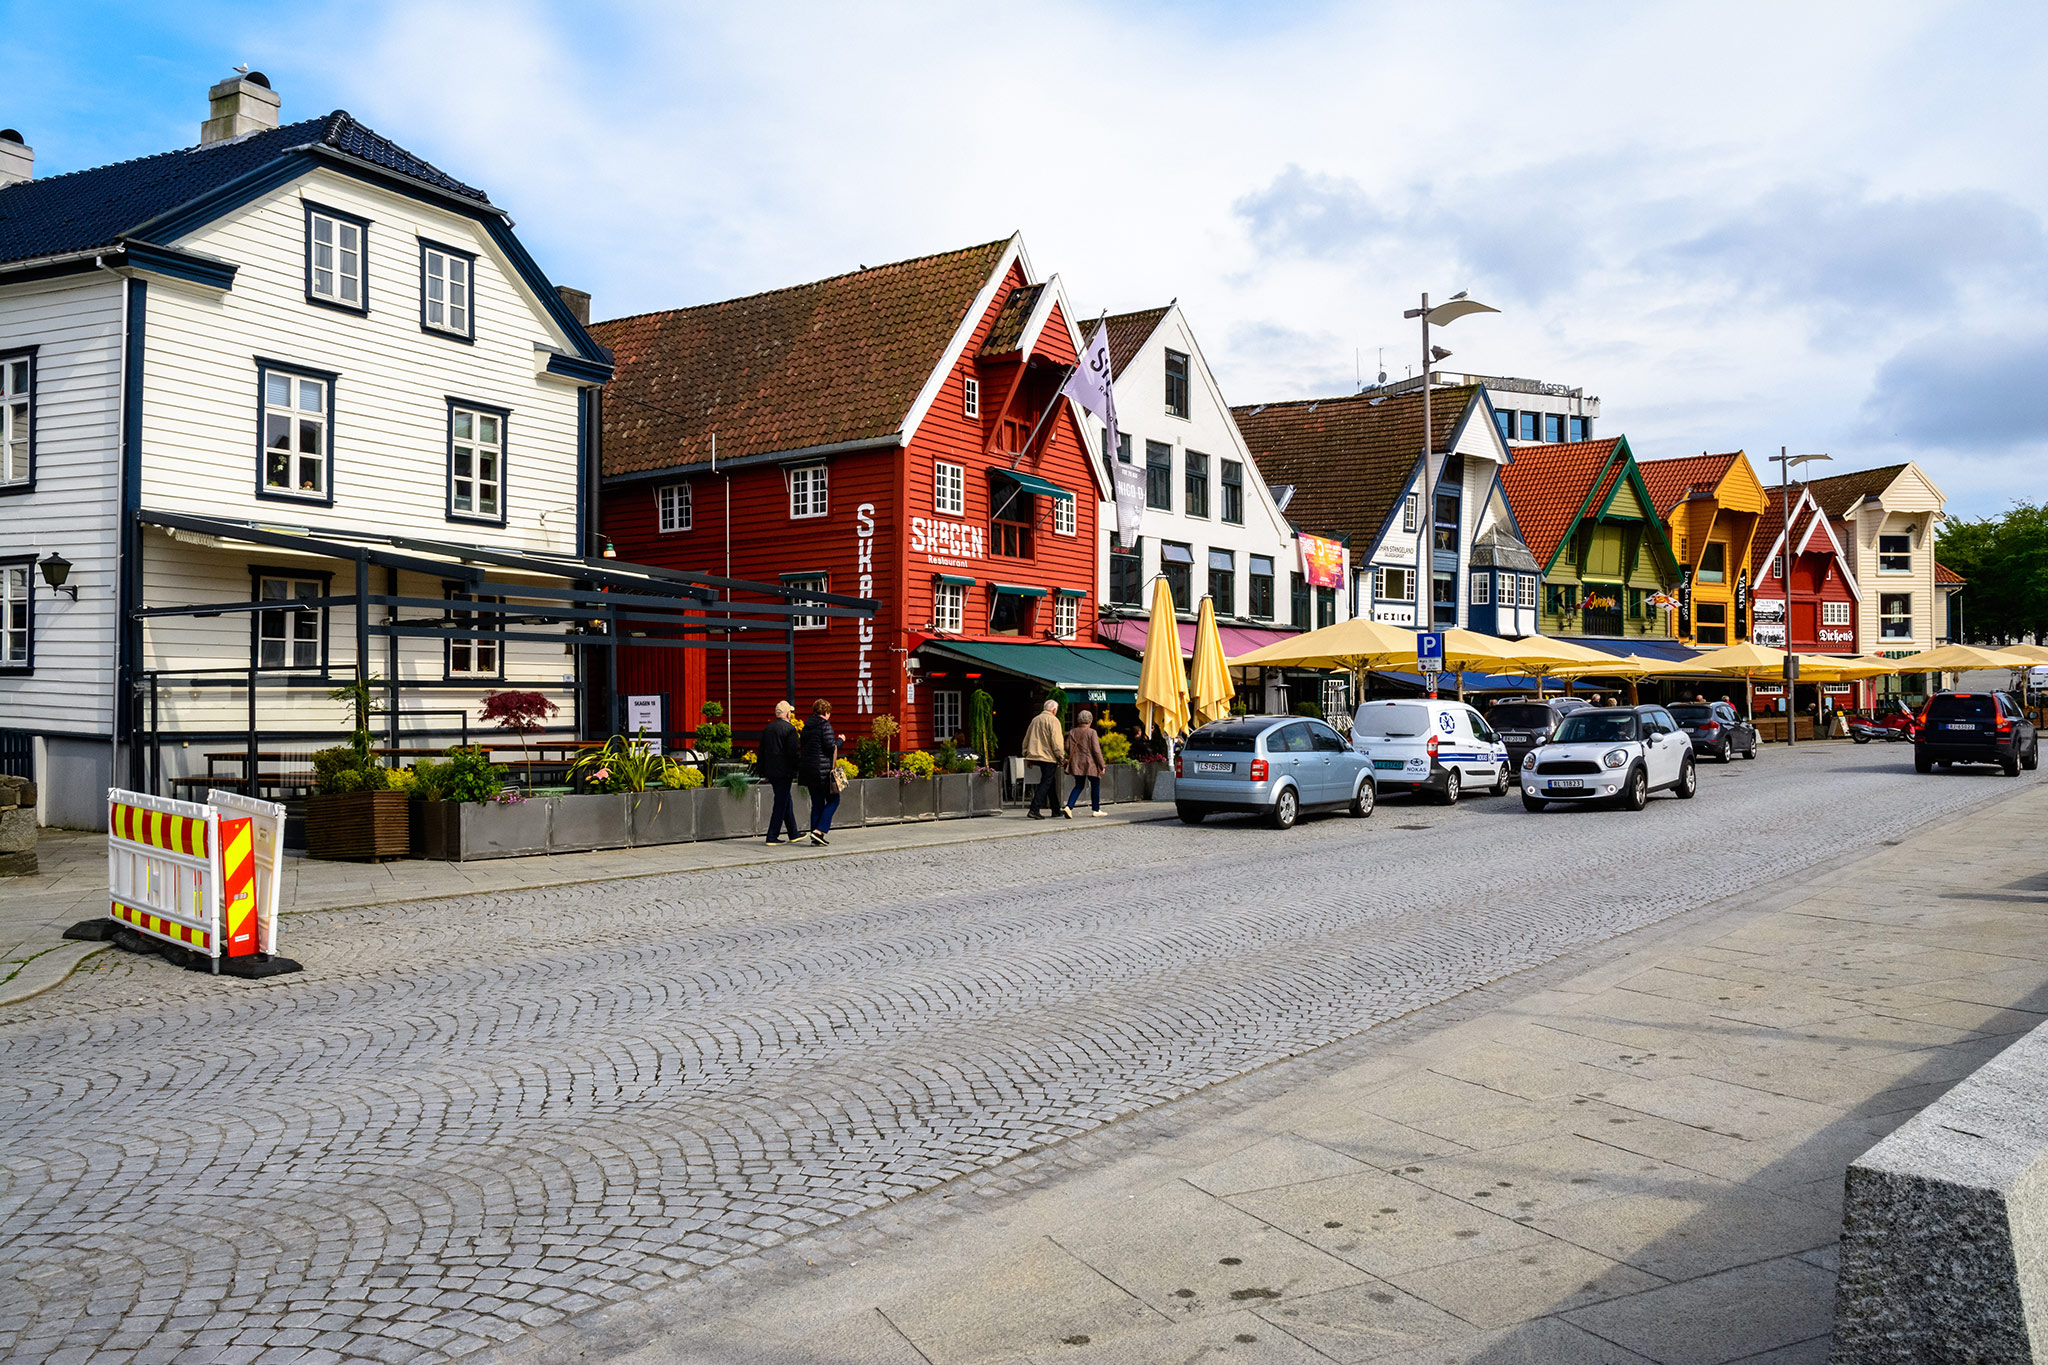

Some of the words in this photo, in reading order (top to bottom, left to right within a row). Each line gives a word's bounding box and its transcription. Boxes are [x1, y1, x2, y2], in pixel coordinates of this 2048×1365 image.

[912, 516, 983, 559] SKAGEN
[928, 554, 968, 568] Restaurant
[857, 503, 875, 714] SKAGEN
[1423, 636, 1436, 656] P
[1819, 629, 1853, 643] Dickens
